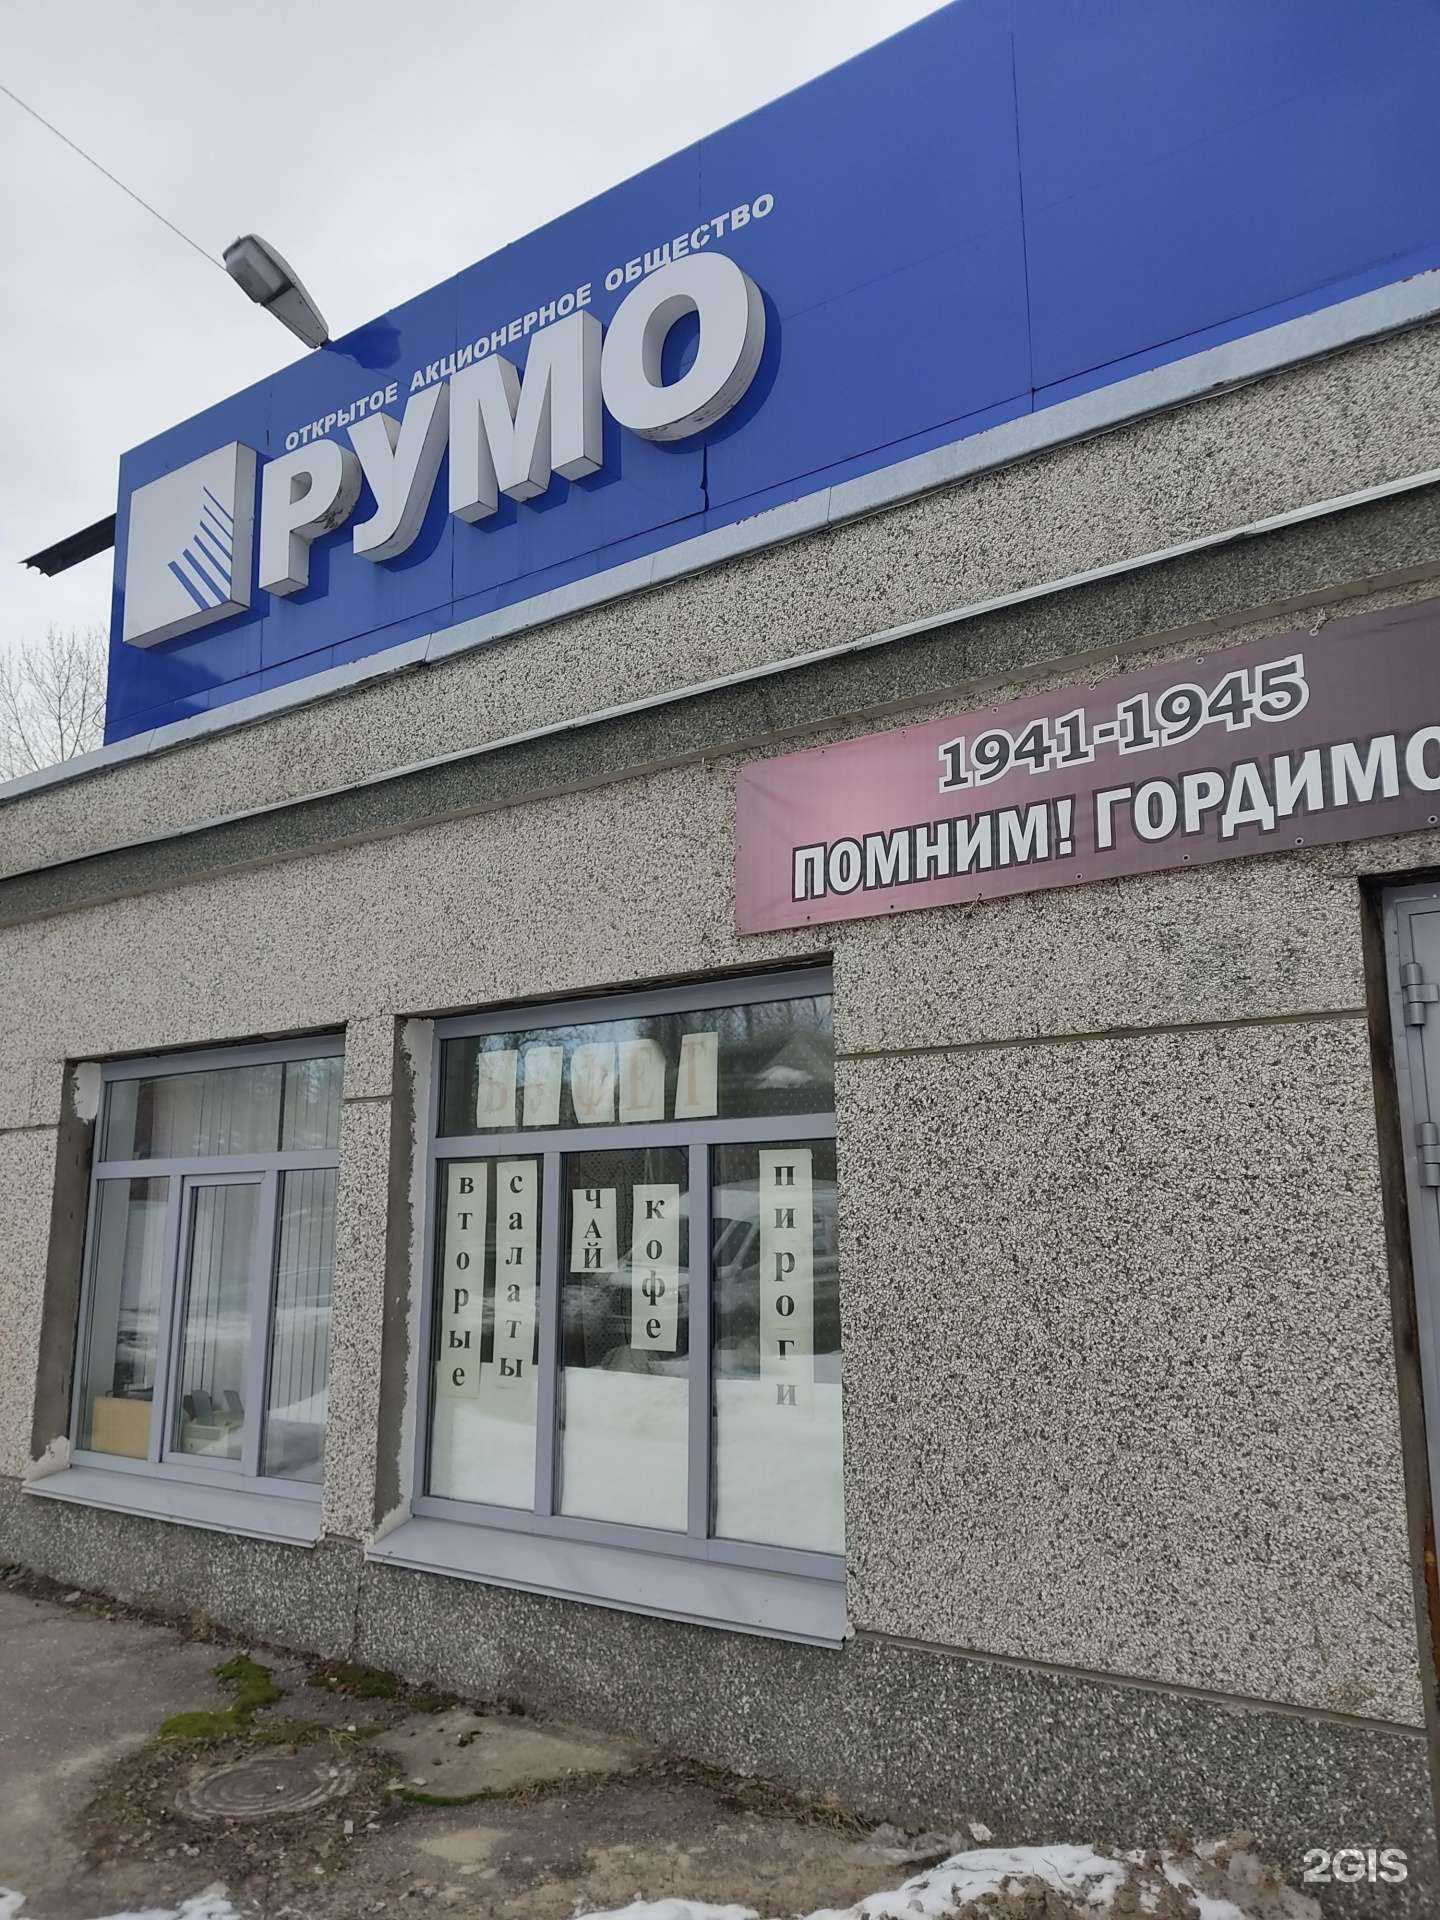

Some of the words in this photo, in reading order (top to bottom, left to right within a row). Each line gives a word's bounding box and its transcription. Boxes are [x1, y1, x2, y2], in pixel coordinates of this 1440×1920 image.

[259, 251, 766, 598] РУМО
[284, 382, 399, 451] ОТКРЫТОЕ
[409, 282, 593, 392] АКЦИОНЕРНОЕ
[604, 193, 775, 293] ОБЩЕСТВО
[938, 653, 1310, 792] 1941-1945
[793, 794, 1074, 902] ПОМНИМ!
[449, 1176, 475, 1387] вторые
[498, 1175, 524, 1378] салаты
[641, 1199, 666, 1339] кофе
[773, 1165, 798, 1406] пироги
